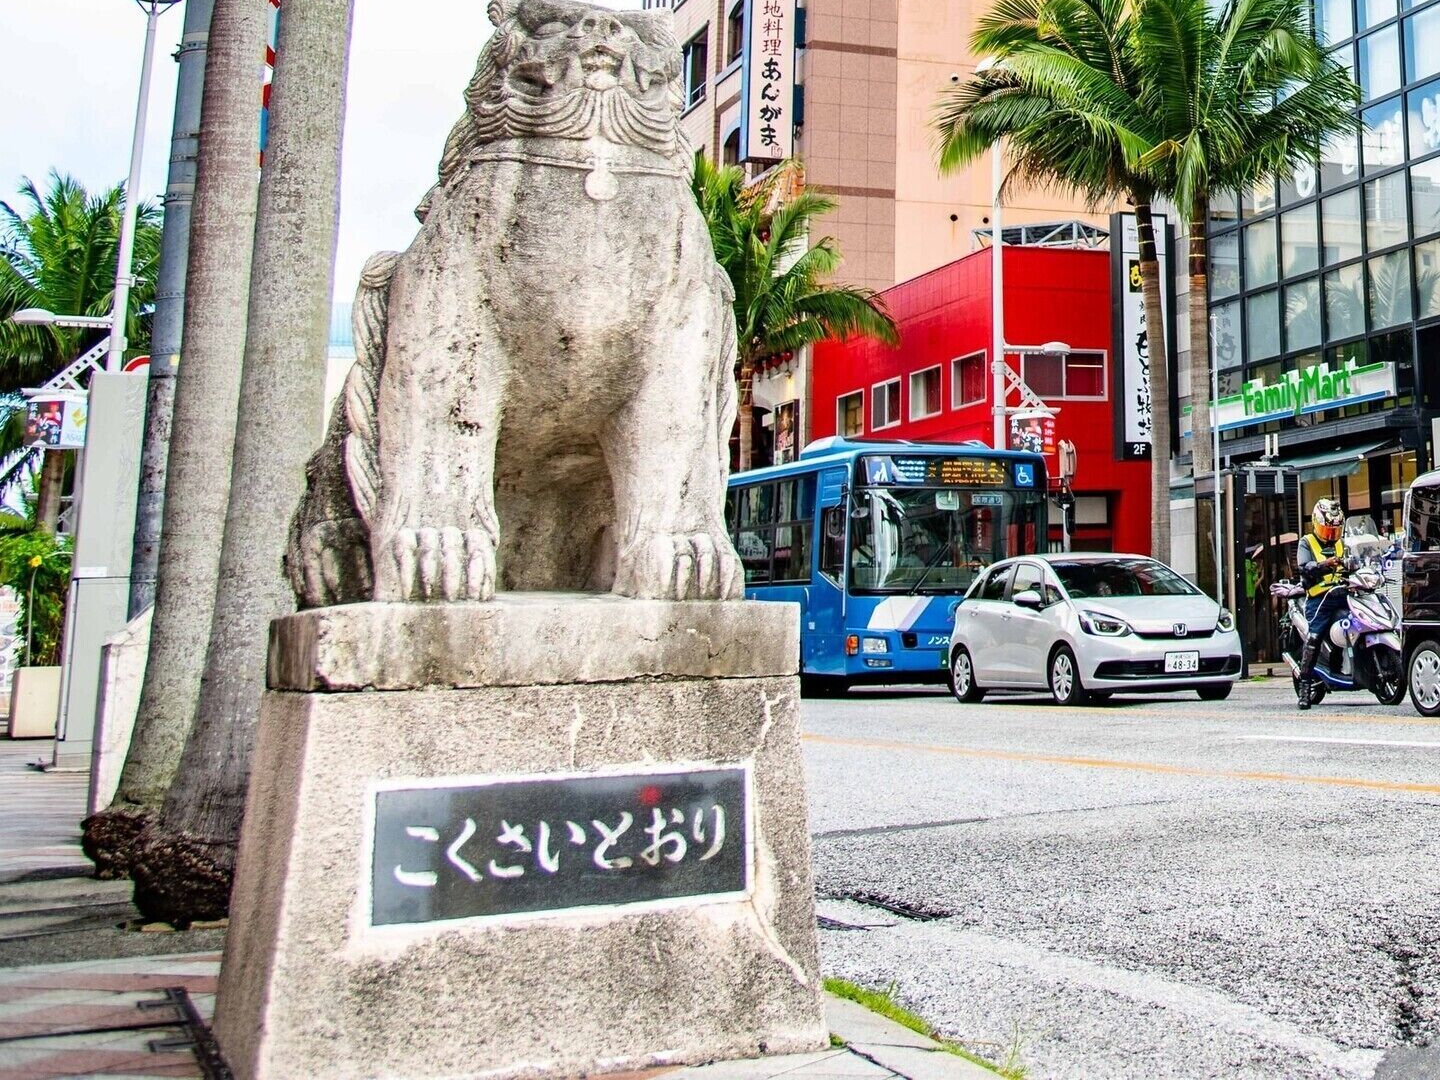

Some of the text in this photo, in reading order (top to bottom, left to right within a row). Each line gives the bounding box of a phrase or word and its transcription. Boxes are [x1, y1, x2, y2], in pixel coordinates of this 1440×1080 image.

[759, 58, 783, 147] あんがま
[1242, 360, 1354, 416] FamilyMart
[1133, 443, 1146, 455] 2F
[393, 802, 727, 888] こくさいとおり
